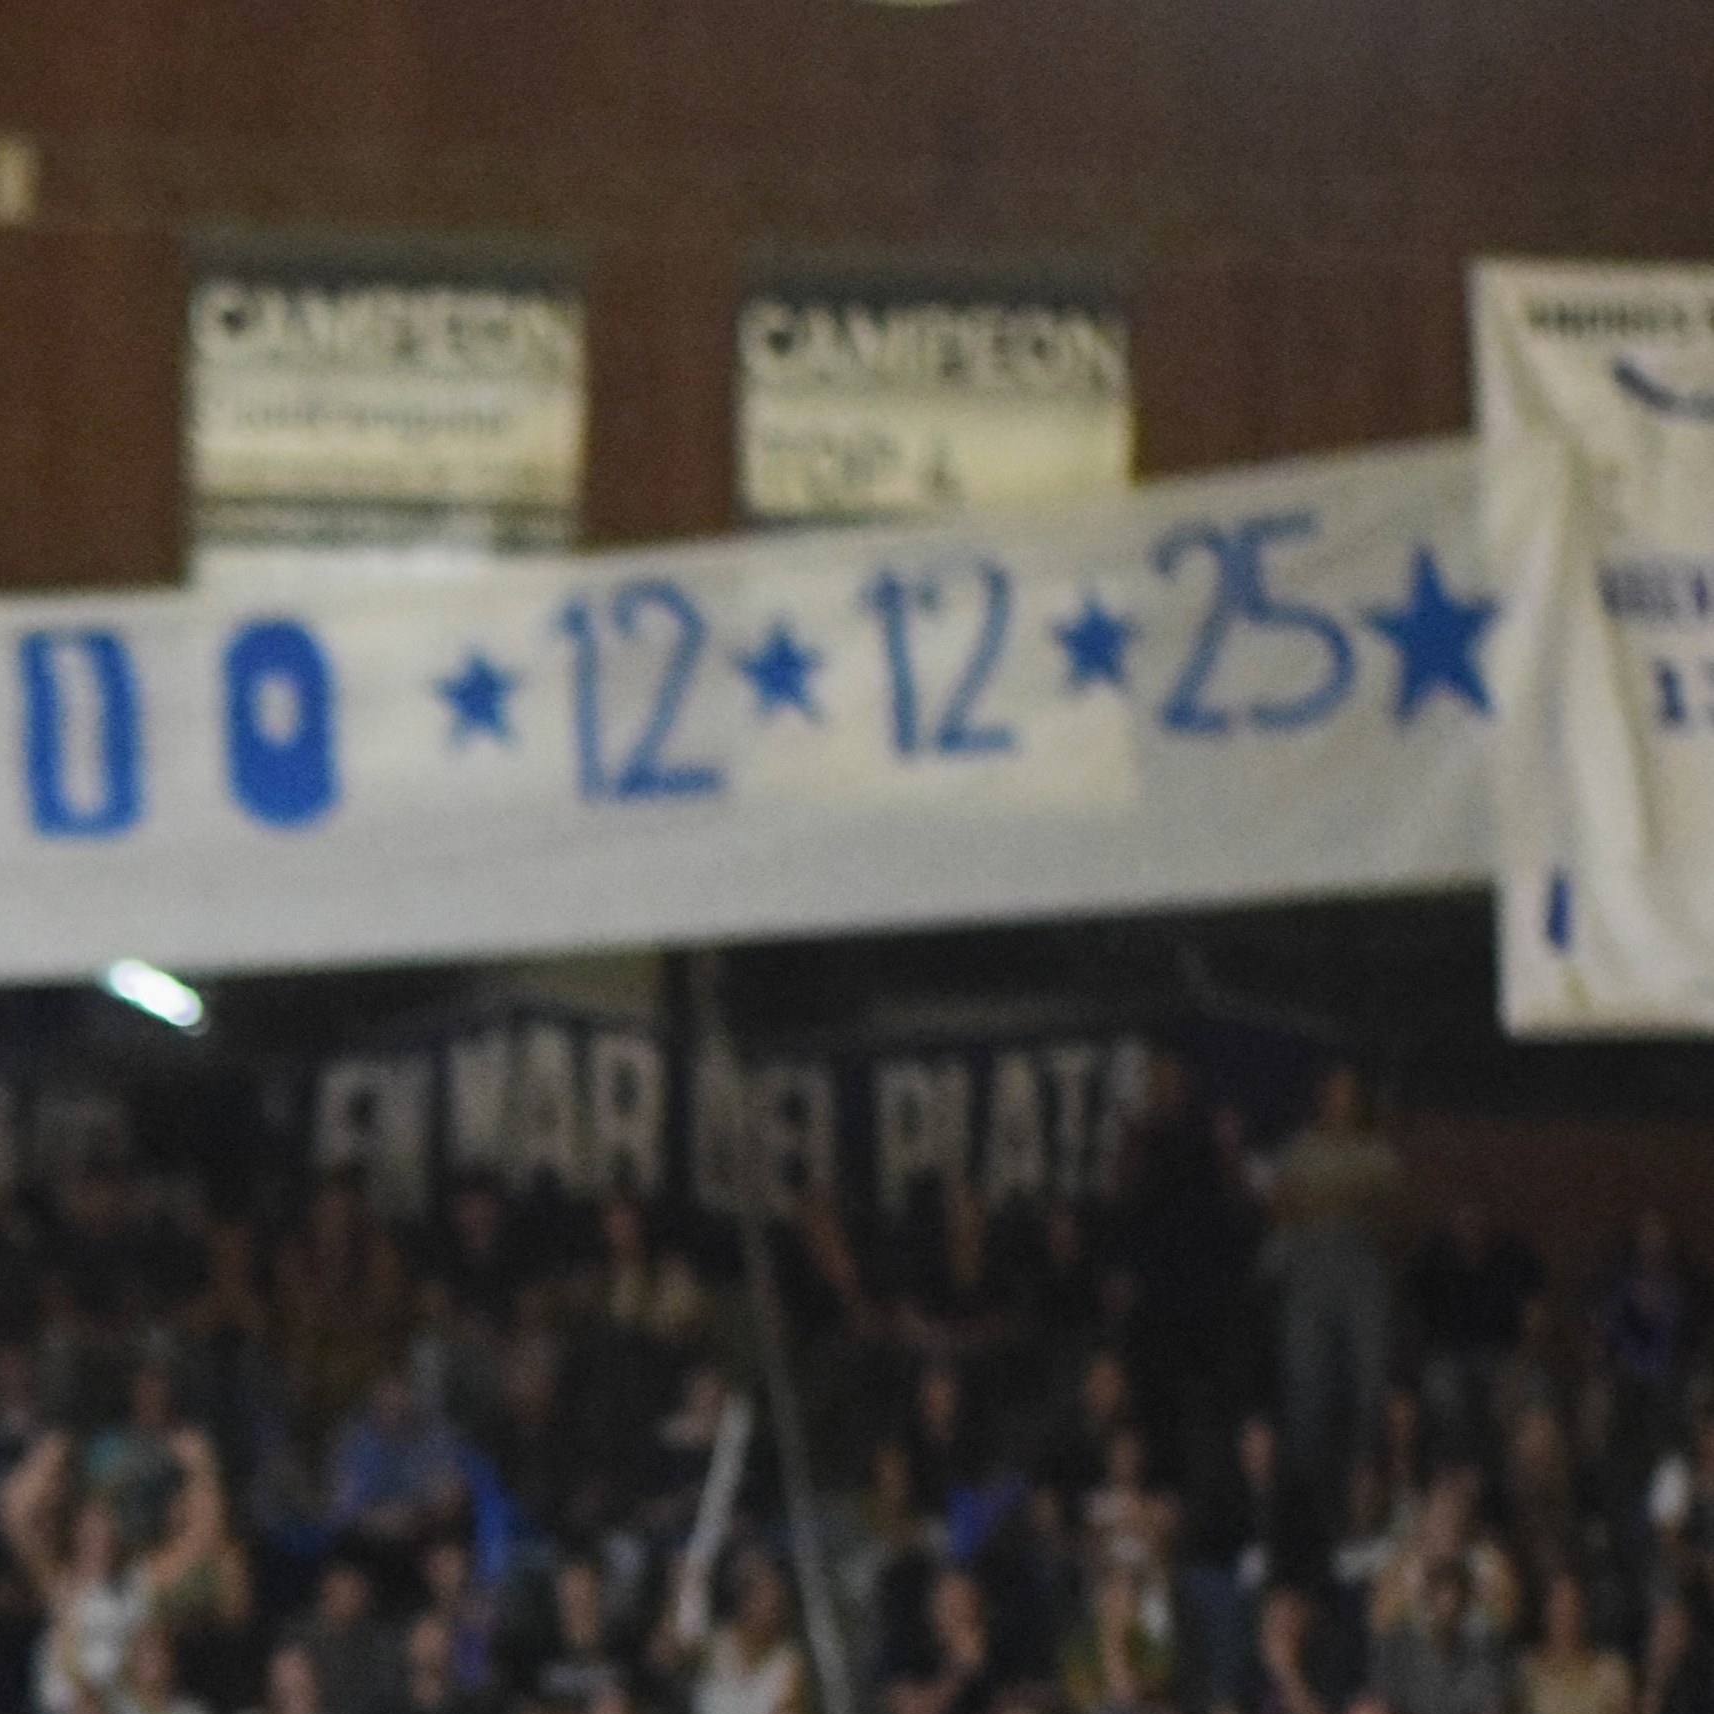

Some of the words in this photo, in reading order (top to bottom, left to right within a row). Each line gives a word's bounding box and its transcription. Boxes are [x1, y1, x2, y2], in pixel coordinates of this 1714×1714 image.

[555, 578, 726, 805] 12
[857, 556, 1017, 760] 12
[1152, 510, 1357, 736] 25
